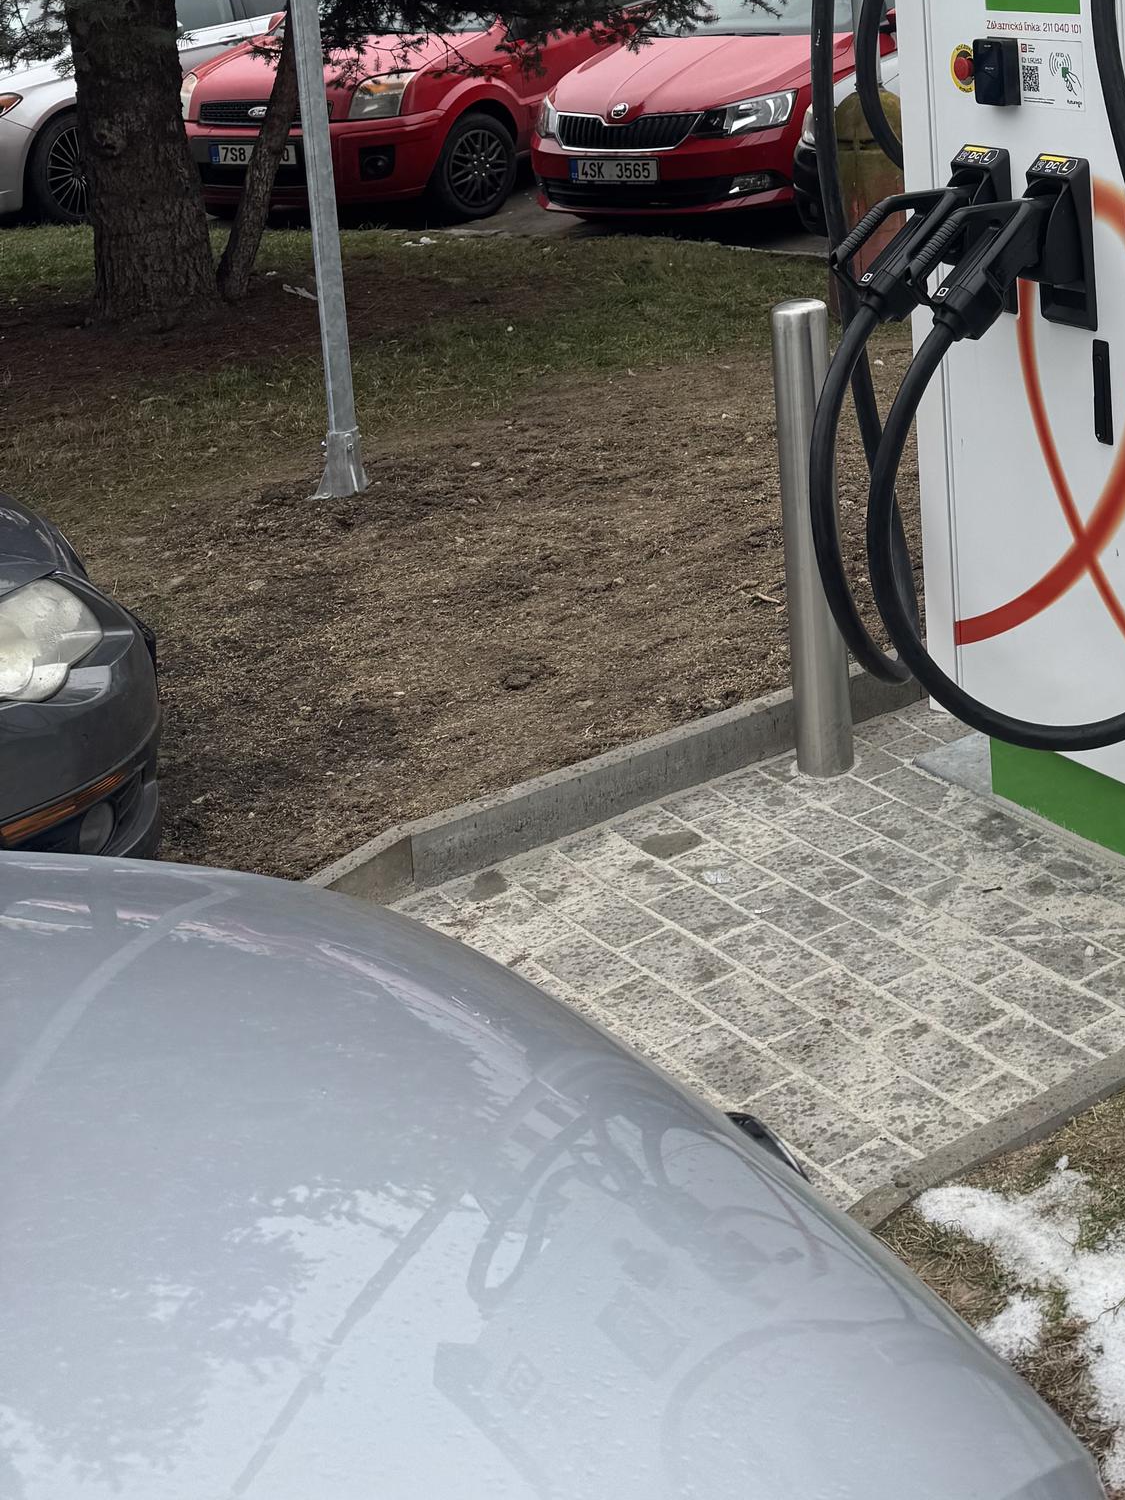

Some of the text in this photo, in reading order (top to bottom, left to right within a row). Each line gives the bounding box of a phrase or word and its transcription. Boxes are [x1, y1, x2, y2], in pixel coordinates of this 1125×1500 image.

[221, 146, 247, 162] 7S8
[968, 151, 982, 160] DC
[581, 161, 651, 179] 4SK 3565
[1045, 161, 1058, 170] DC
